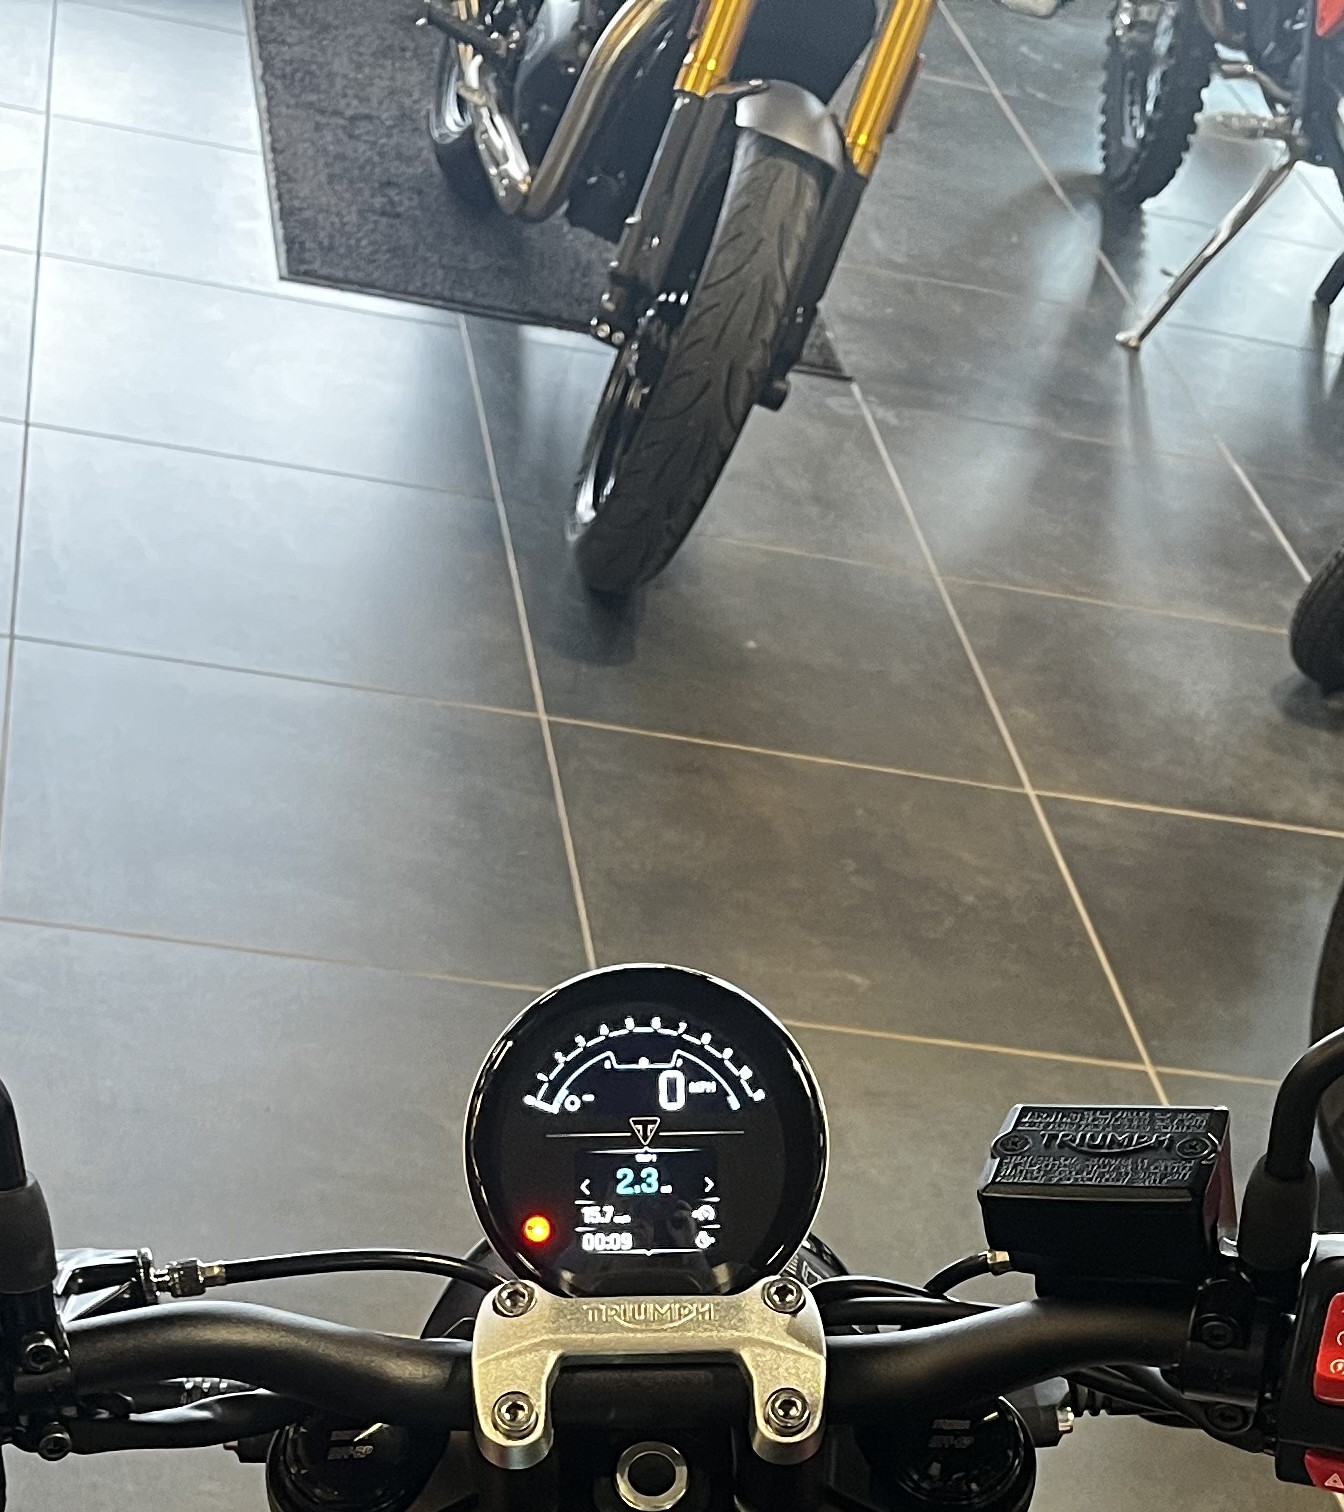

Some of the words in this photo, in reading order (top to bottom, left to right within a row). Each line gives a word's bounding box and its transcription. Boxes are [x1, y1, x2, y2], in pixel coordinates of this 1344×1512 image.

[658, 1069, 686, 1111] 0
[1039, 1130, 1173, 1153] TRIUMPH
[616, 1166, 659, 1195] 2.3
[582, 1232, 633, 1250] 00:09
[582, 1303, 716, 1330] TRIUMPH
